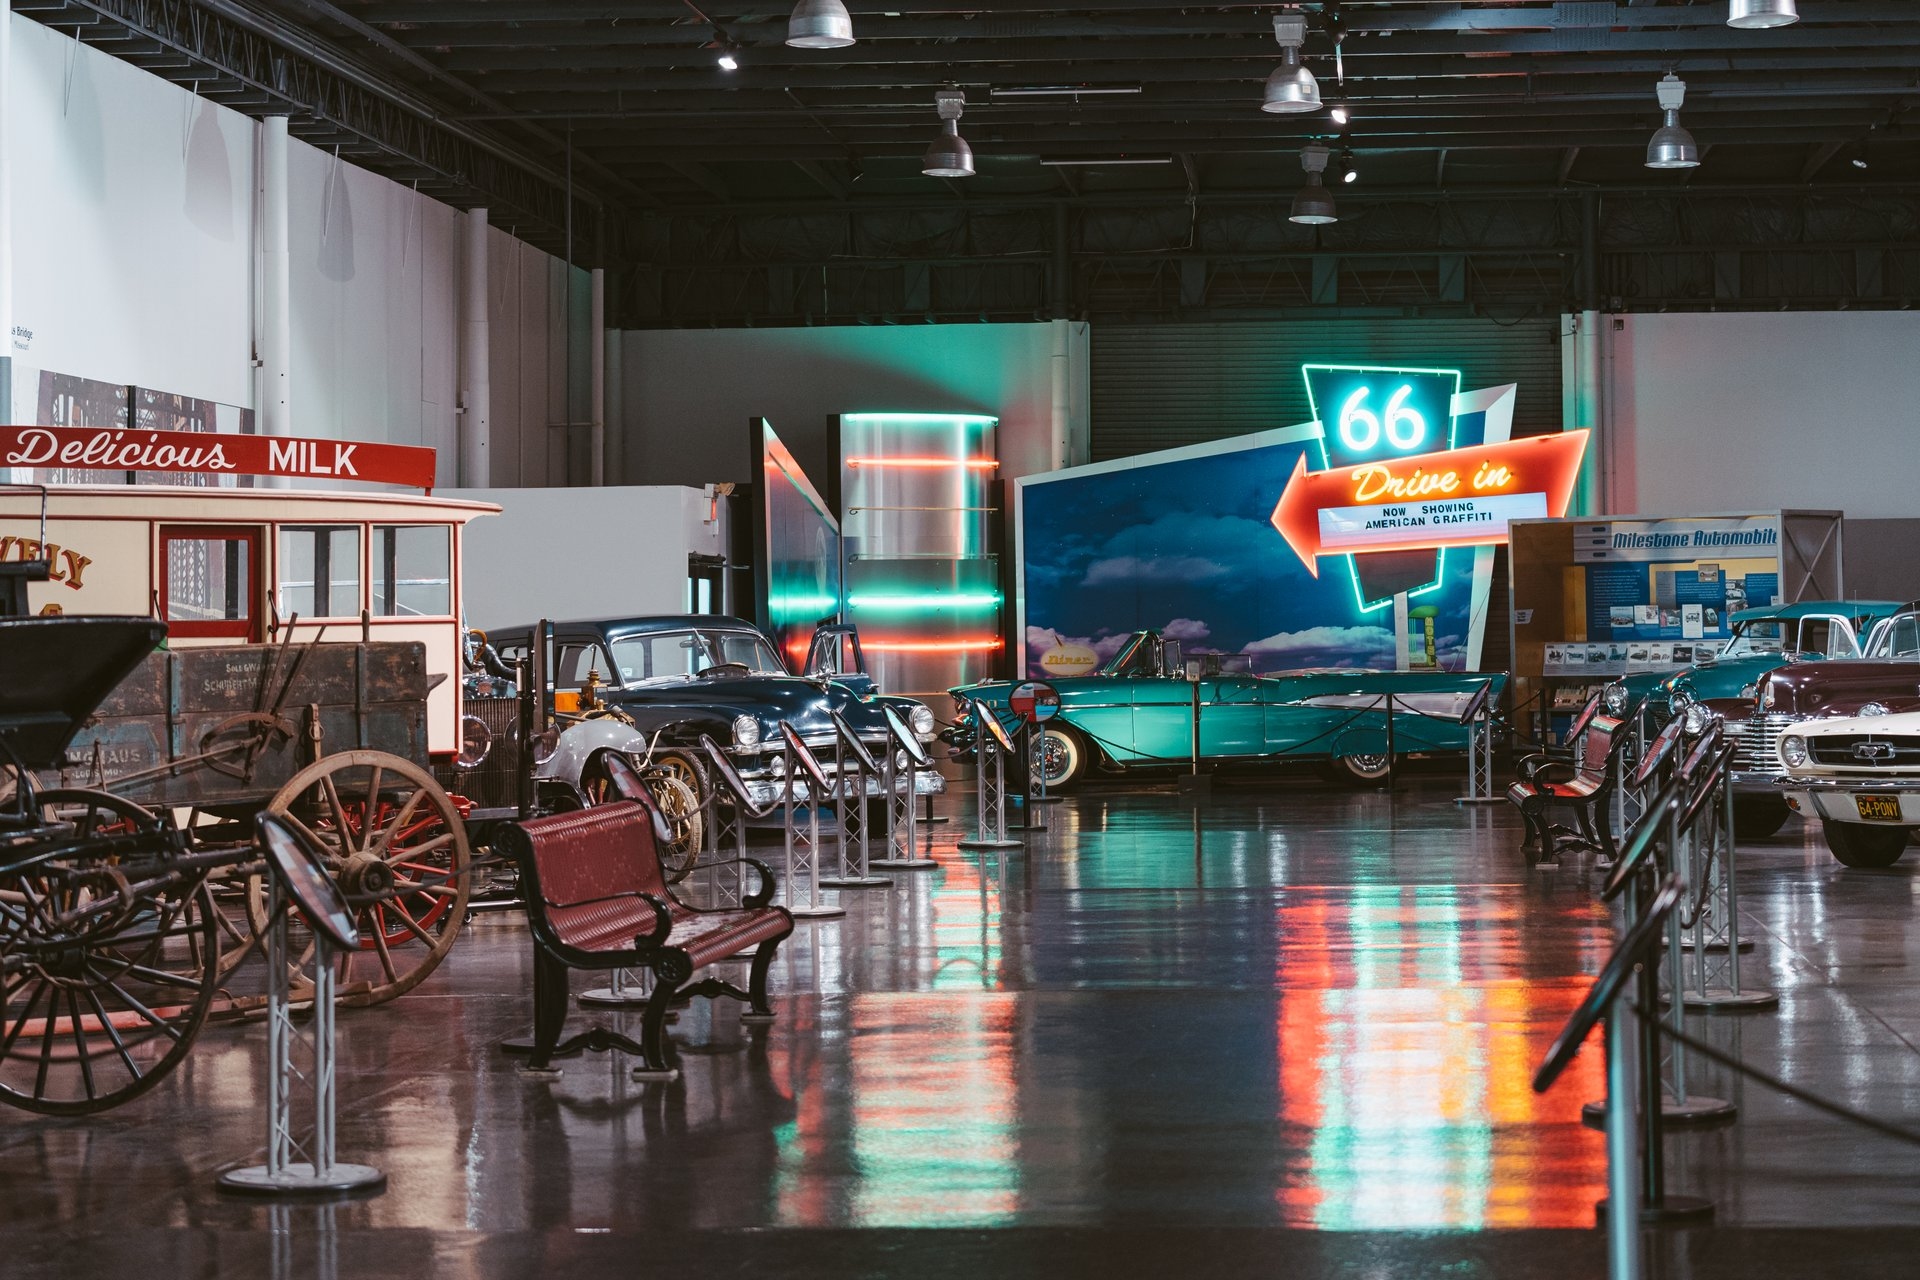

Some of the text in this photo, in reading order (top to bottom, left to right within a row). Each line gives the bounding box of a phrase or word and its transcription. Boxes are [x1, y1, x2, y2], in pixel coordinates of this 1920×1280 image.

[1339, 384, 1426, 450] 66
[6, 428, 359, 476] Delicious MILK
[1351, 460, 1512, 502] Drive in
[1383, 502, 1474, 517] NOW SHOWING
[1365, 512, 1492, 529] AMERICAN GRAFFITI
[1612, 533, 1689, 549] Milestone
[1424, 616, 1436, 667] MOTEL
[1048, 654, 1092, 665] Diner
[1858, 801, 1898, 817] 64-PONY
